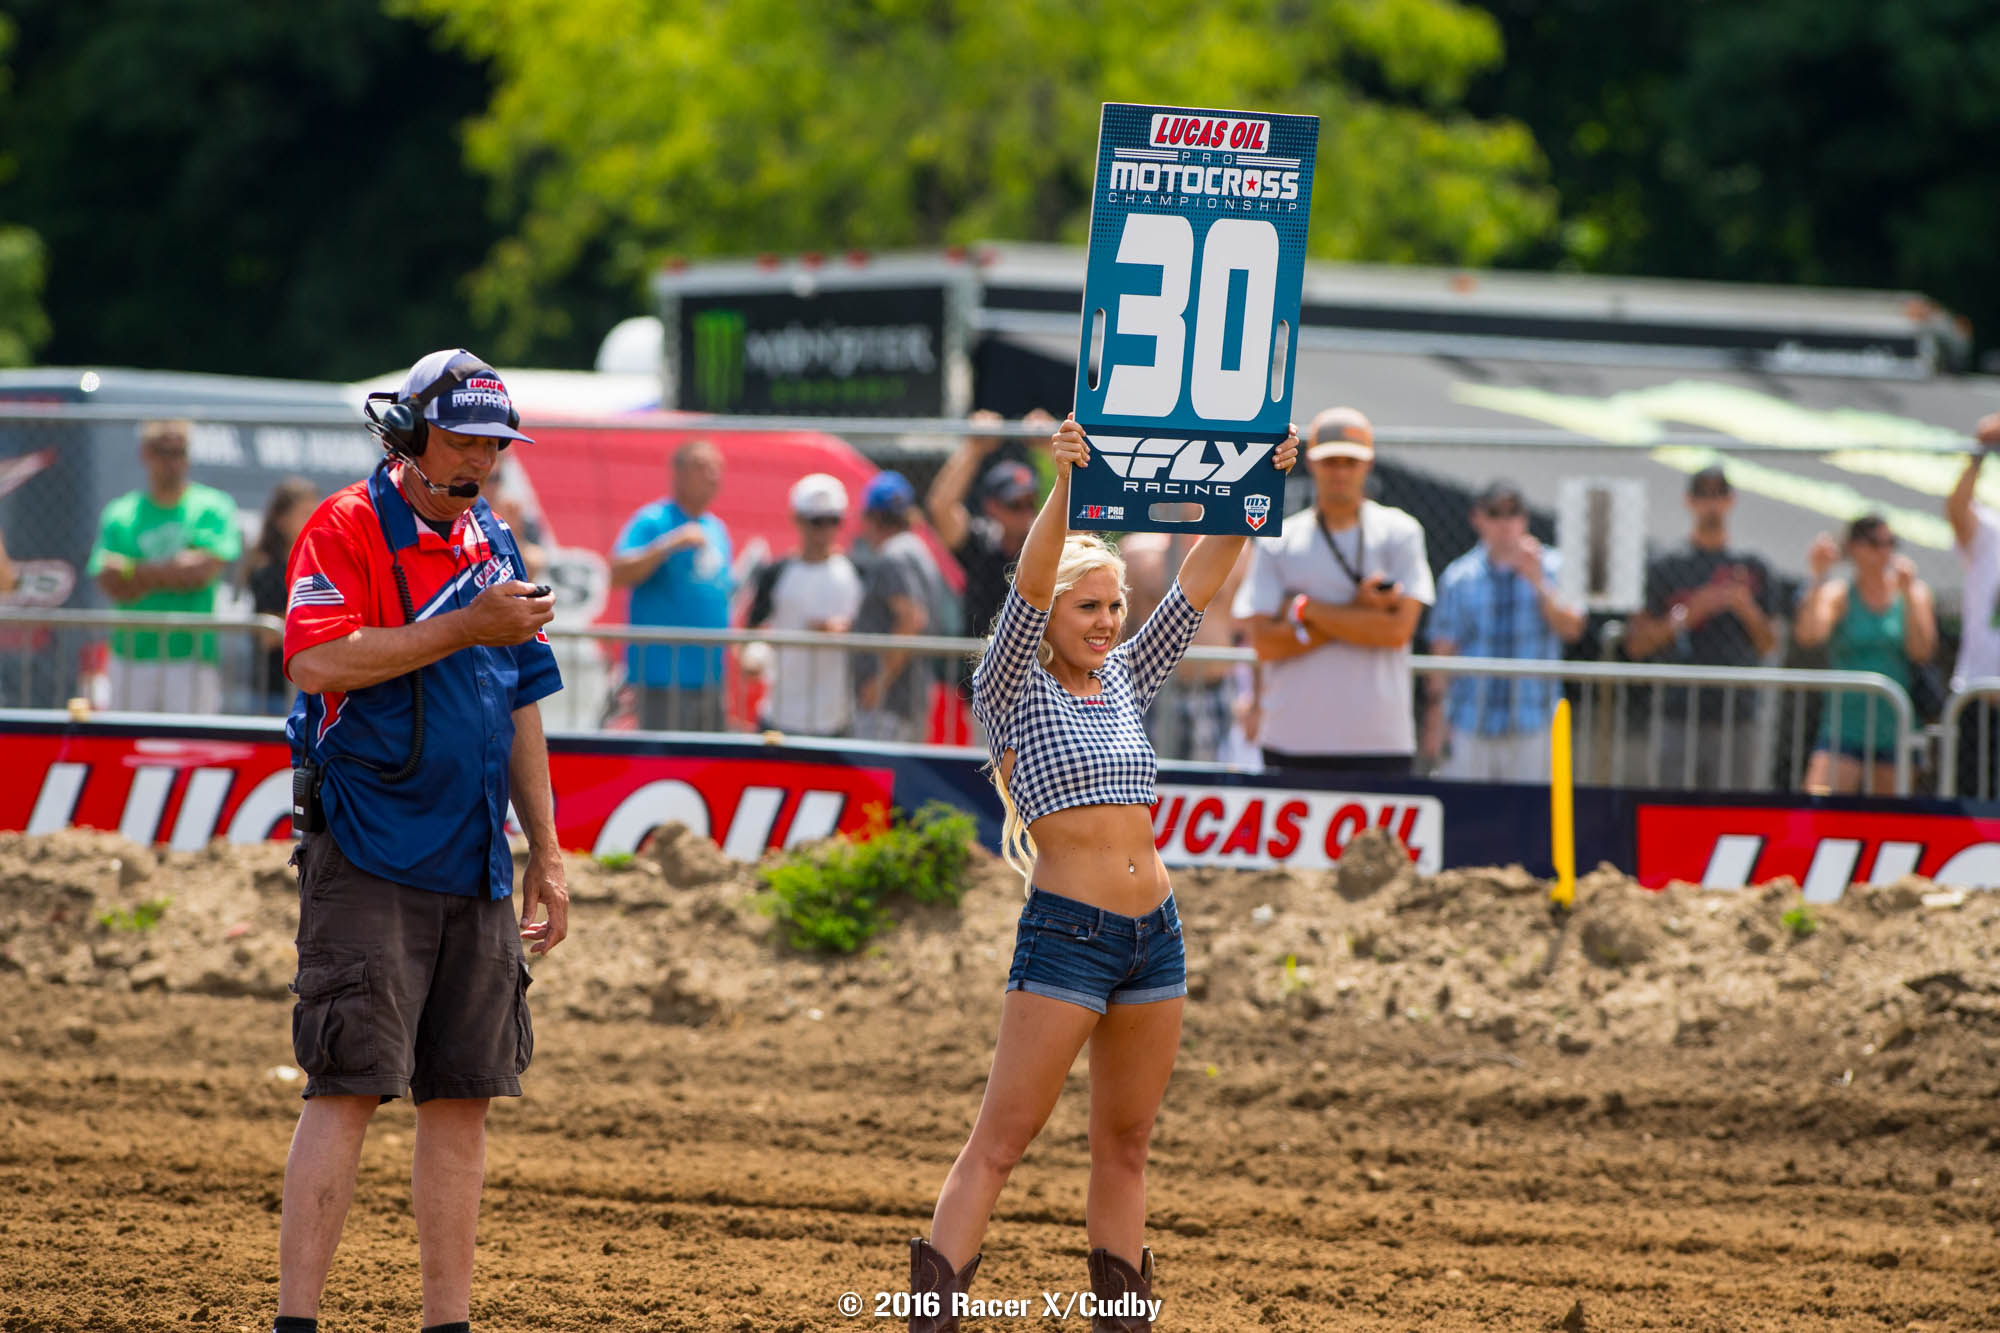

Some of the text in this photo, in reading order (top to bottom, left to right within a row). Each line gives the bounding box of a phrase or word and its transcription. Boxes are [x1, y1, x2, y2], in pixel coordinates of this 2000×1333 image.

[1155, 117, 1265, 150] LUCAS OIL
[1182, 151, 1233, 165] PRO
[1109, 161, 1300, 200] MOTOCROSS
[1108, 192, 1297, 212] CHAMPIONSHIP
[1101, 213, 1280, 422] 30
[1100, 435, 1275, 483] FLY
[1123, 481, 1232, 496] RACING
[1076, 505, 1124, 519] AMA PRO
[1246, 497, 1269, 507] MX
[1149, 795, 1309, 860] UCAS
